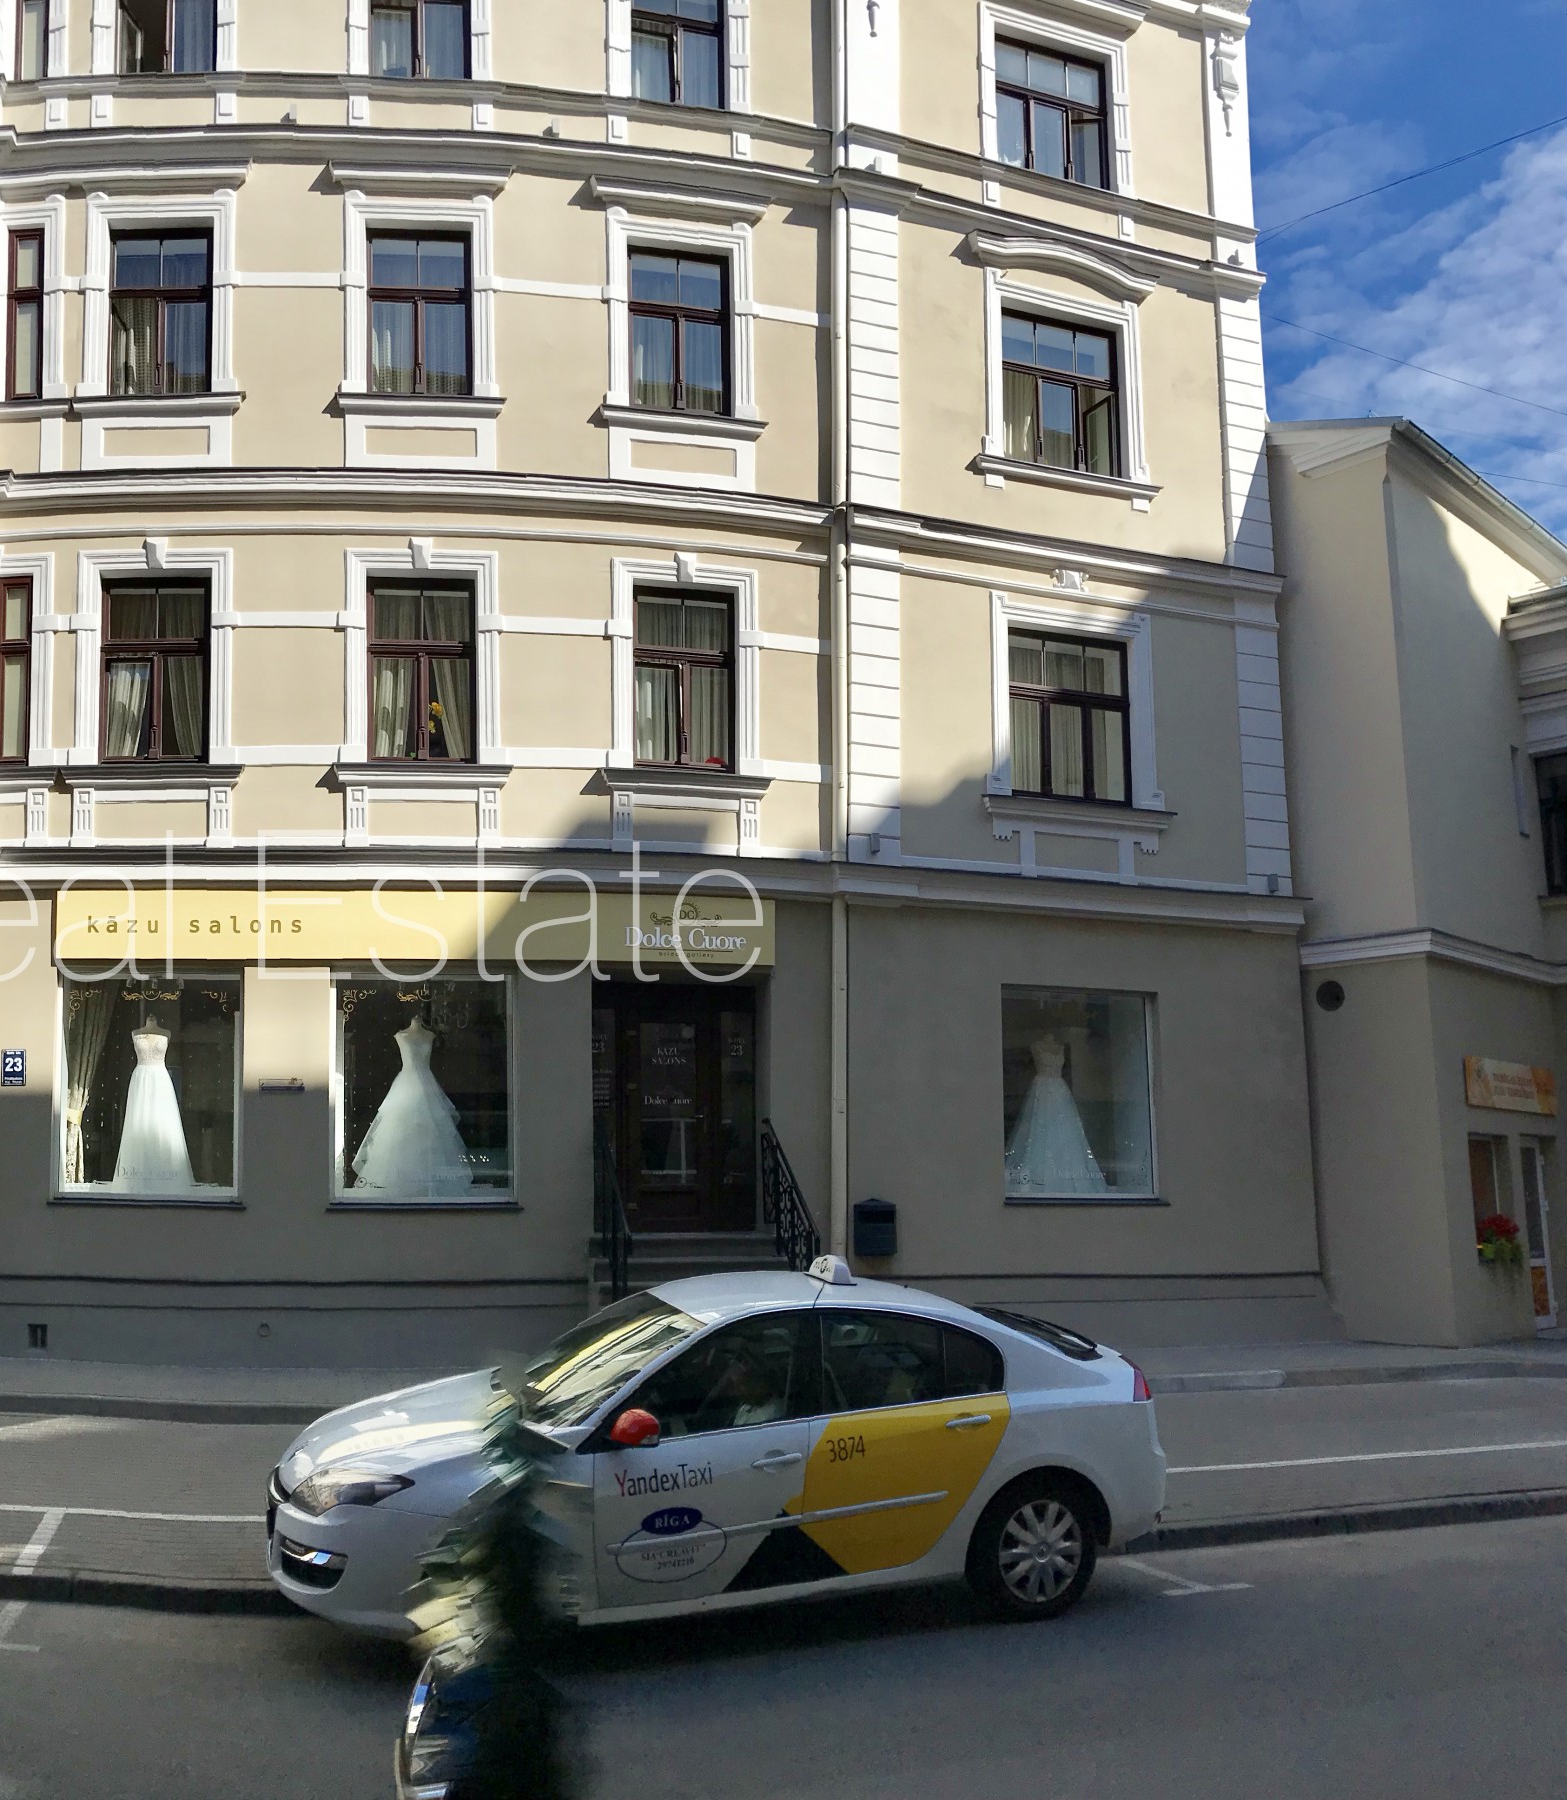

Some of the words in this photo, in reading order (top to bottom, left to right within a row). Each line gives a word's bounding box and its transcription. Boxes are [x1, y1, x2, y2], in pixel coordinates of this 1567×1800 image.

[87, 915, 160, 934] kāzu
[188, 915, 303, 934] salons
[624, 926, 682, 949] Dolce
[688, 928, 747, 950] Cuore
[5, 1057, 23, 1072] 23
[825, 1435, 866, 1463] 3874
[614, 1461, 714, 1497] YandexTaxi
